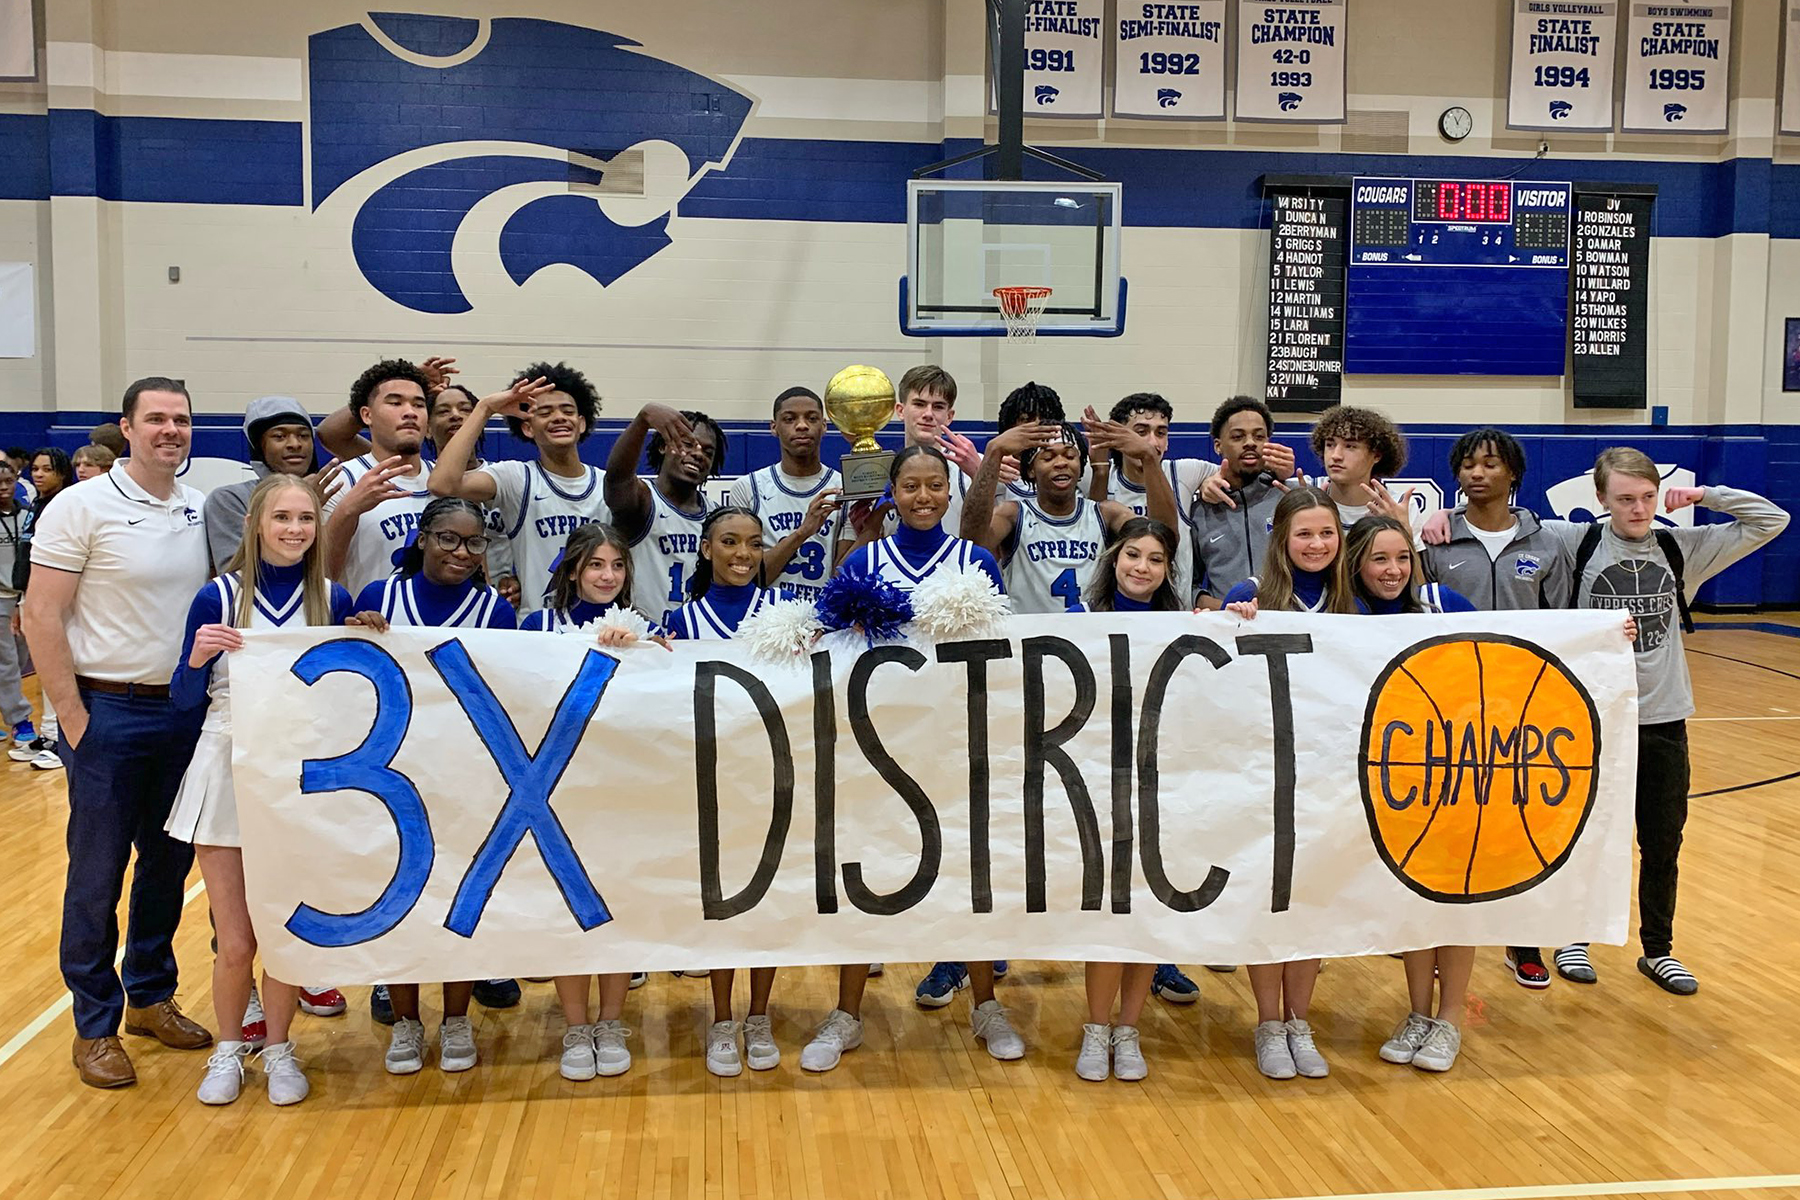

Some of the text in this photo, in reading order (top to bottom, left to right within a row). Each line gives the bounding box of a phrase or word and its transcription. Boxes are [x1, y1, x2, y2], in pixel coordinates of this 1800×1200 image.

[1142, 4, 1200, 20] STATE
[1529, 3, 1604, 14] GIRLS VOLLEYBALL
[1647, 7, 1713, 17] BOYS SWIMMING
[1264, 8, 1320, 24] STATE
[1120, 19, 1221, 43] SEMI-FINALIST
[1537, 19, 1592, 35] STATE
[1652, 22, 1706, 38] STATE
[1251, 23, 1334, 47] CHAMPION
[1529, 34, 1600, 56] FINALIST
[1640, 37, 1719, 60] CHAMPION
[1023, 49, 1075, 72] 1991
[1140, 52, 1200, 75] 1992
[1272, 49, 1311, 65] 42-0
[1270, 71, 1312, 87] 1993
[1534, 65, 1590, 88] 1994
[1649, 69, 1706, 91] 1995
[1357, 186, 1408, 204] COUGARS
[1517, 190, 1566, 208] VISITOR
[1607, 199, 1620, 210] JV
[1274, 210, 1326, 225] 1 DUNCAN
[1578, 211, 1633, 224] 1 ROBINSON
[1577, 224, 1635, 238] 2 GONZALES
[1275, 237, 1322, 251] 3 GRIGGS
[1418, 235, 1439, 244] 1 2
[1482, 236, 1502, 246] 3 4
[1576, 238, 1583, 249] 3
[1276, 251, 1323, 265] 4 HADNOT
[1362, 252, 1389, 262] BONUS
[1532, 255, 1558, 265] BONUS
[1576, 251, 1628, 264] 5 BOWMAN
[1273, 264, 1322, 278] 5 TAYLOR
[1576, 264, 1630, 277] 10 WATSON
[1271, 278, 1315, 291] 11 LEWIS
[1576, 277, 1631, 290] 11 WILLARD
[1271, 292, 1321, 305] 12 MARTIN
[1575, 290, 1616, 303] 14 YAPO
[1270, 305, 1334, 319] 14 WILLIAMS
[1575, 304, 1627, 316] 15 THOMAS
[1270, 319, 1309, 331] 15 LARA
[1574, 317, 1627, 329] 20 WILKES
[1269, 332, 1331, 345] 21 FLORENT
[1574, 330, 1627, 342] 21 MORRIS
[1574, 343, 1620, 355] 23 ALLEN
[1027, 539, 1099, 562] CYPRESS
[1050, 568, 1082, 609] 4
[284, 633, 1578, 948] 3X DISTRICT CHAMPS
